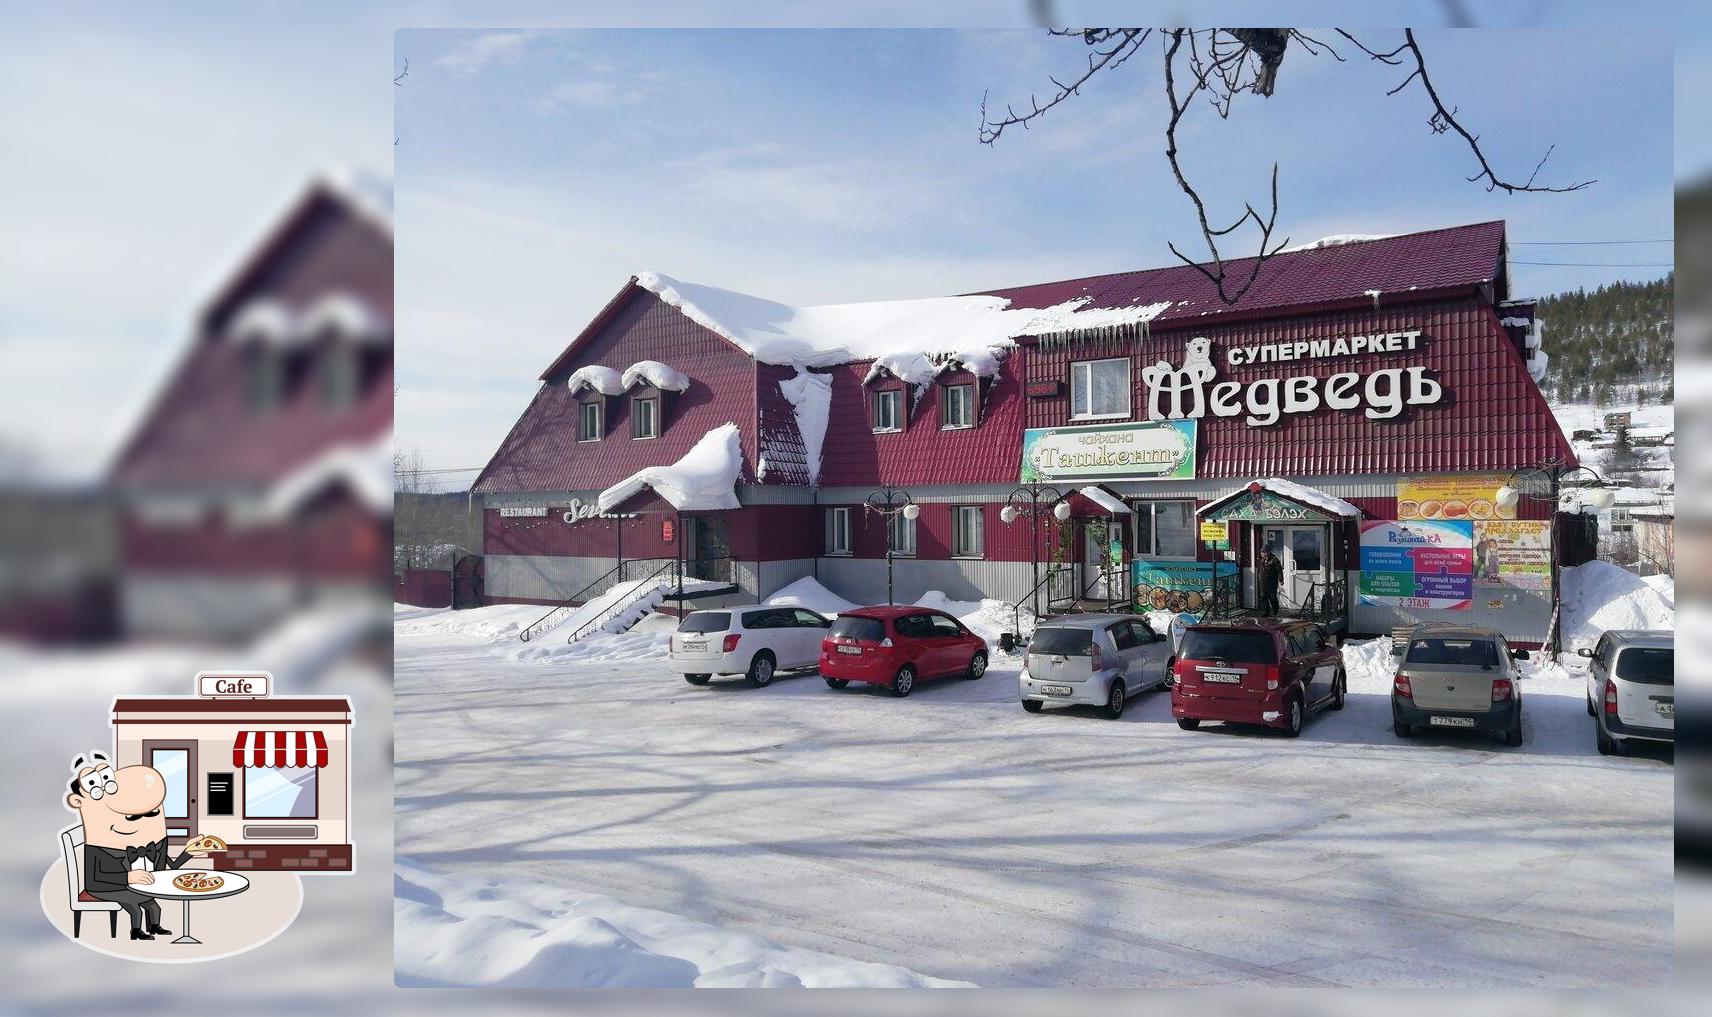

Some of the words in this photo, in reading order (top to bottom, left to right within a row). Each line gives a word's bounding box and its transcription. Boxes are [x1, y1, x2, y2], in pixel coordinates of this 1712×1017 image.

[1227, 330, 1421, 366] СУПЕРМАРКЕТ
[1141, 364, 1443, 427] Медведь
[500, 507, 548, 517] RESTAURANT
[1400, 598, 1404, 607] 2
[1407, 598, 1431, 608] ЭТАЖ
